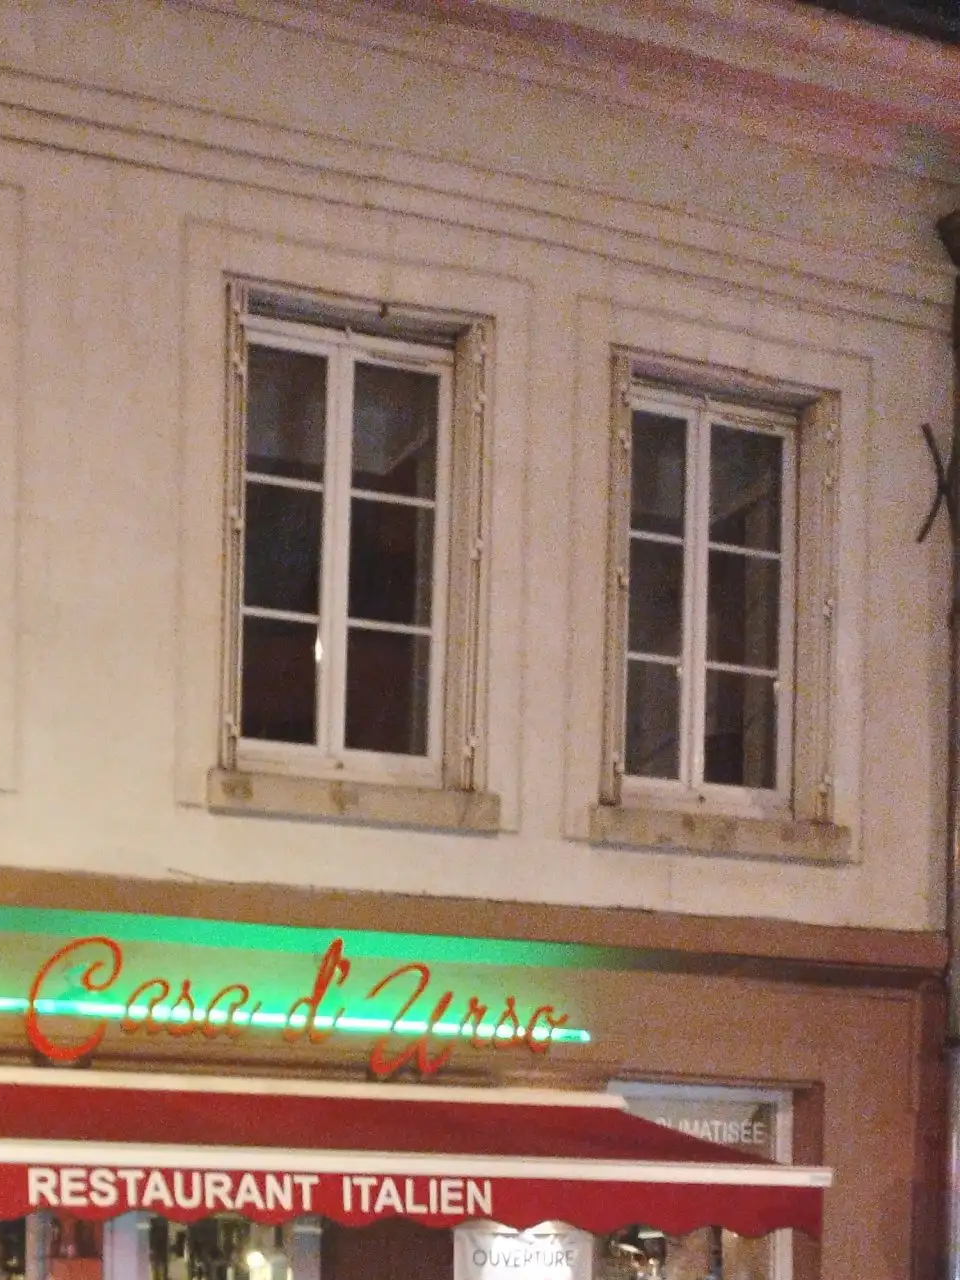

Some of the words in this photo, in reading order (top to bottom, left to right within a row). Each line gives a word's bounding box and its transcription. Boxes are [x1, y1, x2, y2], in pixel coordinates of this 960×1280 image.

[24, 936, 261, 1061] Casa
[27, 1167, 319, 1213] RESTAURANT
[342, 1175, 493, 1216] ITALIEN
[472, 1249, 575, 1268] OUVERTURE
